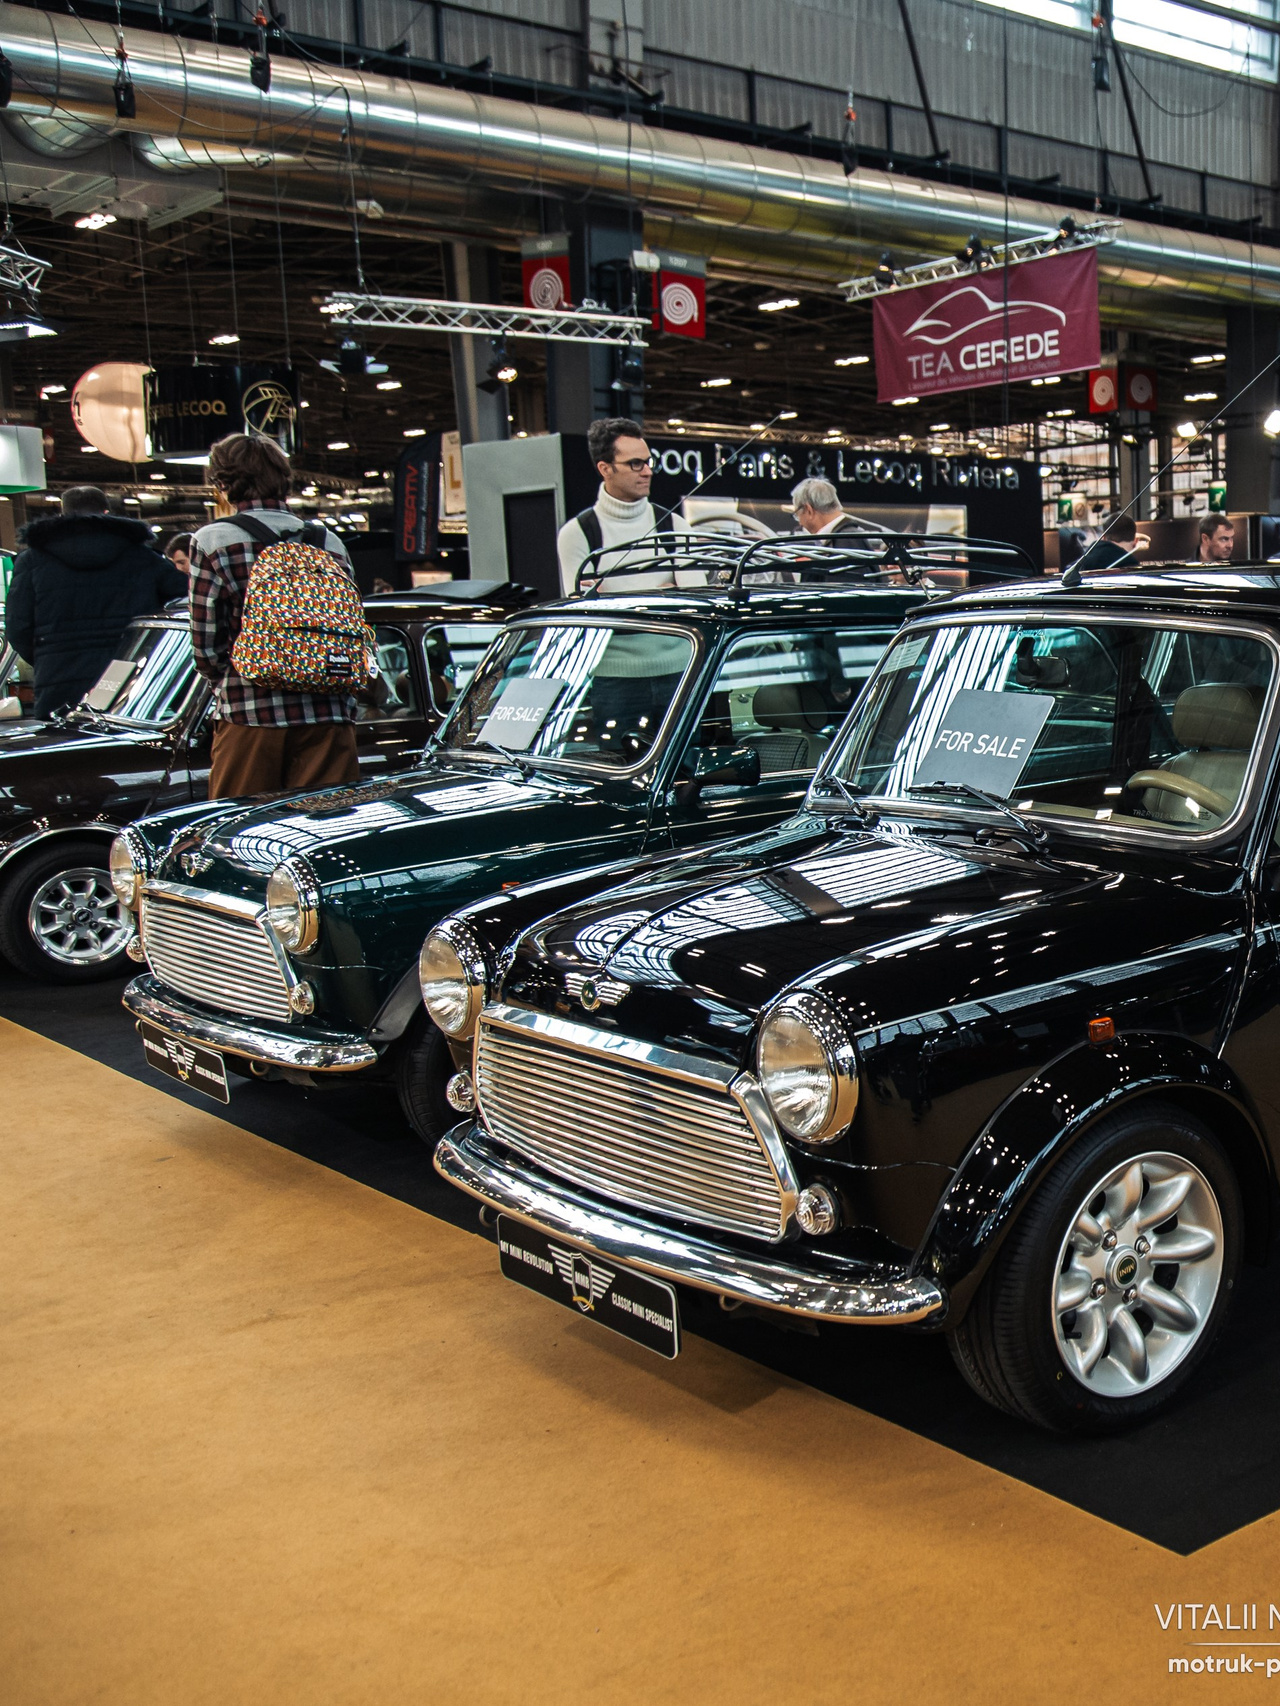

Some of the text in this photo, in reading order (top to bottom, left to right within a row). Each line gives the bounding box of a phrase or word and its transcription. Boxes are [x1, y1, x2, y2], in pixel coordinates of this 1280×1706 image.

[908, 329, 1060, 380] TEA CEREDE
[177, 400, 228, 416] LECOQ
[650, 442, 1020, 492] coq Paris & Lecoq Riviera
[491, 706, 544, 722] FOR SALE
[934, 729, 1027, 759] FOR SALE
[500, 1240, 554, 1275] MY MINI REVOLUTION
[611, 1292, 673, 1333] CLASSIC MINI SPECIALIST
